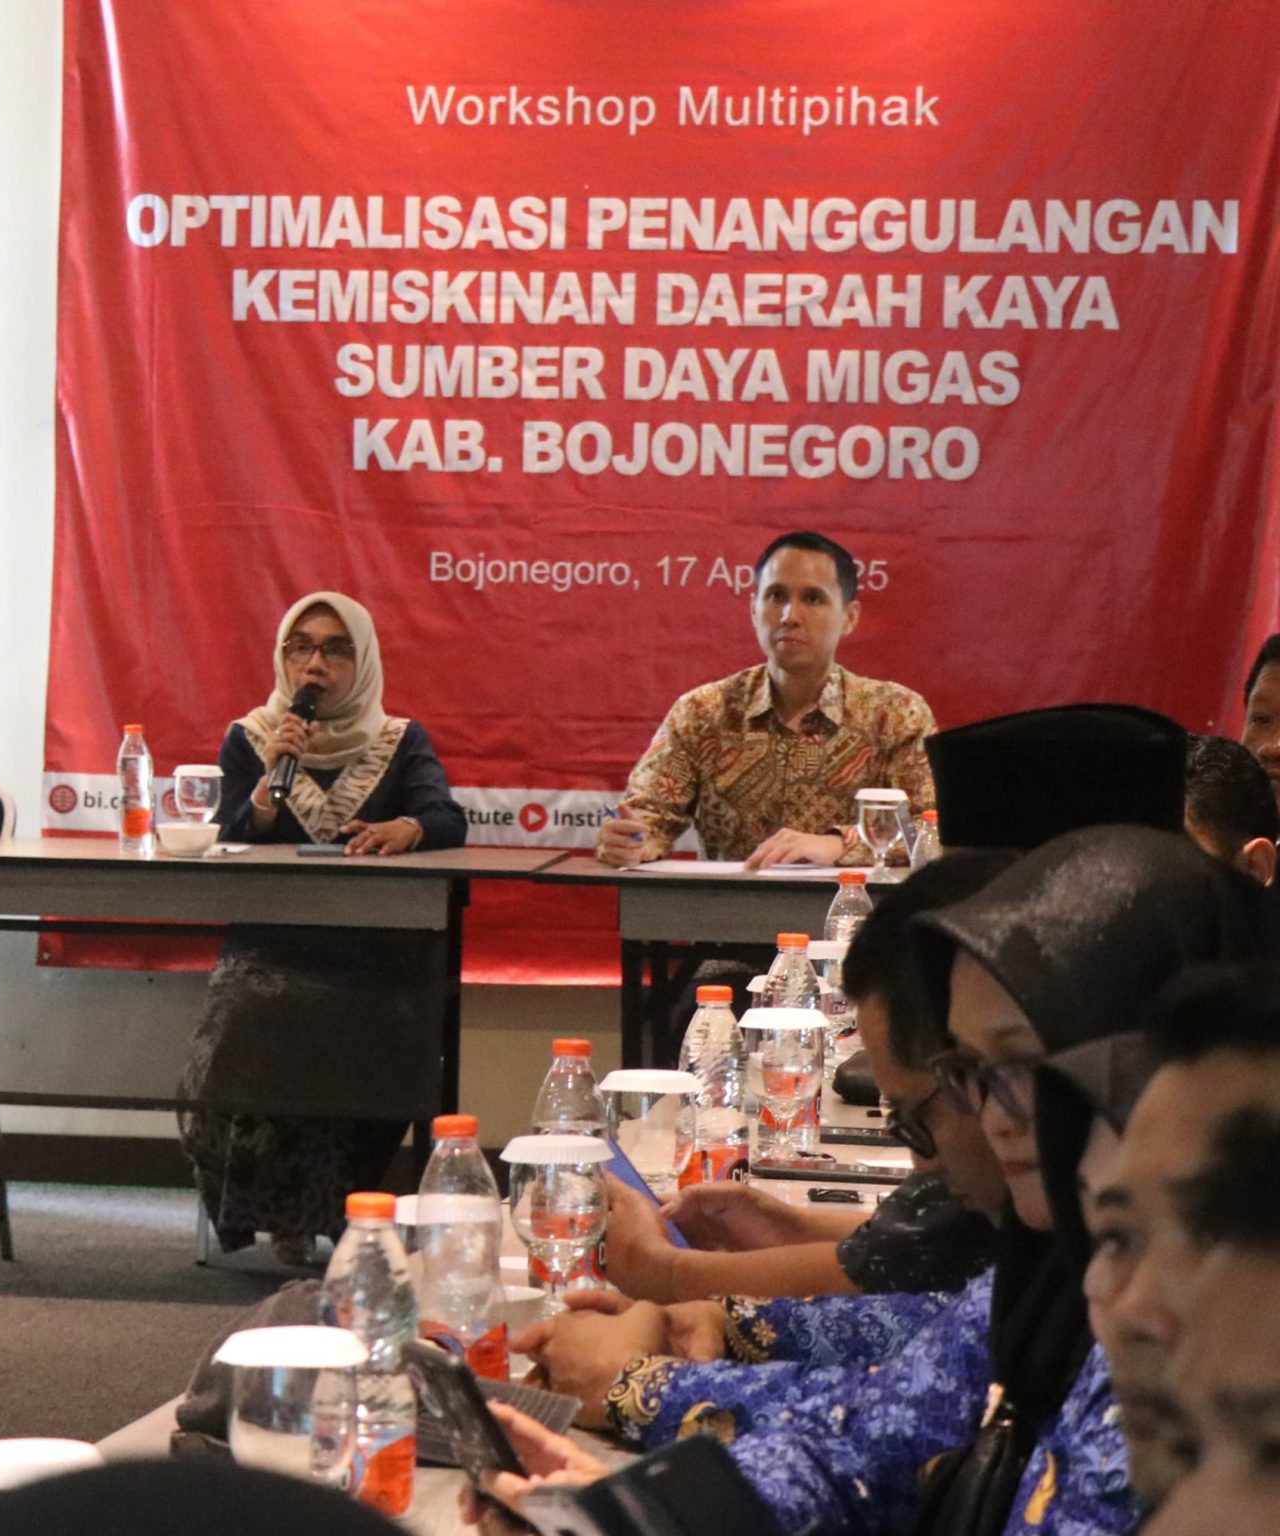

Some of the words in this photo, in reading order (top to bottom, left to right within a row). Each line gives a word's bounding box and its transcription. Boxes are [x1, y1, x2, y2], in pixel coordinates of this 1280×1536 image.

[407, 85, 657, 136] Workshop
[678, 85, 940, 137] Multipihak
[126, 194, 567, 251] OPTIMALISASI
[586, 196, 1239, 254] PENANGGULANGAN
[232, 268, 636, 325] KEMISKINAN
[656, 272, 922, 328] DAERAH
[943, 275, 1120, 330] KAYA
[334, 343, 607, 400] SUMBER
[623, 346, 789, 402] DAYA
[807, 349, 1020, 405] MIGAS
[353, 418, 503, 473] KAB.
[522, 420, 980, 480] BOJONEGORO
[430, 552, 639, 591] Bojonegoro,
[658, 556, 697, 586] 17
[706, 556, 756, 595] Ap
[851, 559, 889, 591] 25
[83, 791, 120, 810] bi.c
[467, 808, 515, 827] tute
[553, 809, 603, 828] Insti
